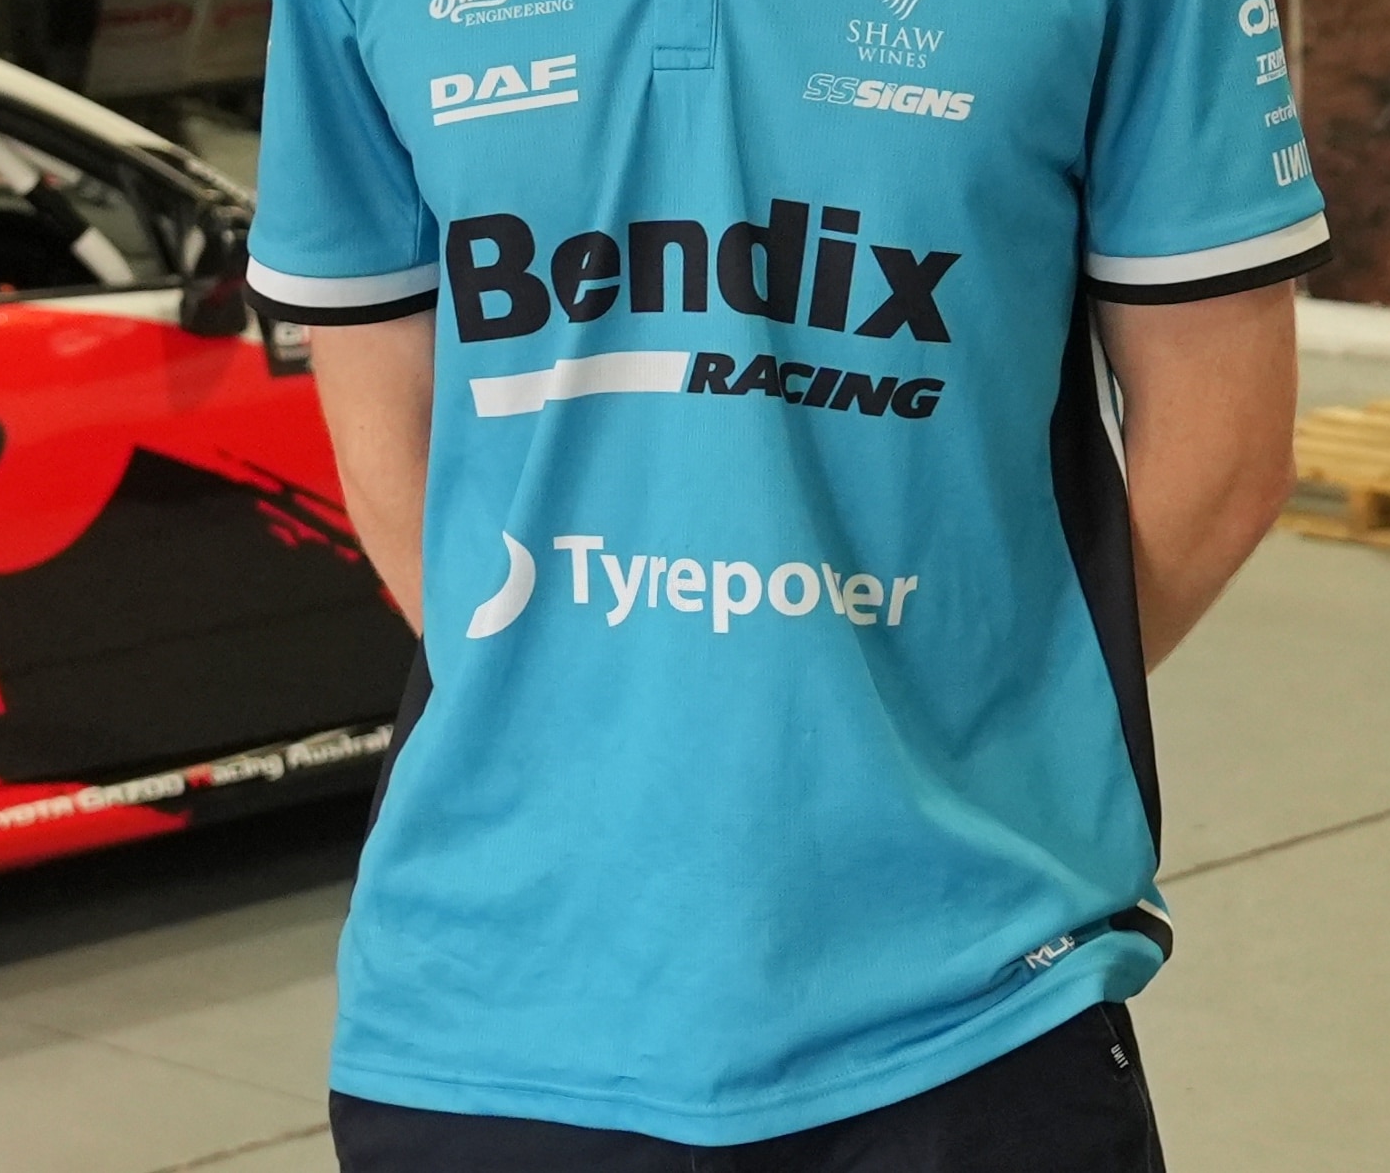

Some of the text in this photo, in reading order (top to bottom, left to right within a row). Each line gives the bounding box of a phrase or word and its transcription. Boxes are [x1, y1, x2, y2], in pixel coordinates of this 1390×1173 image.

[846, 19, 944, 53] SHAW
[858, 45, 927, 69] WINES
[430, 54, 577, 109] DAF
[446, 198, 962, 344] Bendix
[687, 352, 946, 419] RACING
[285, 724, 394, 771] Austral
